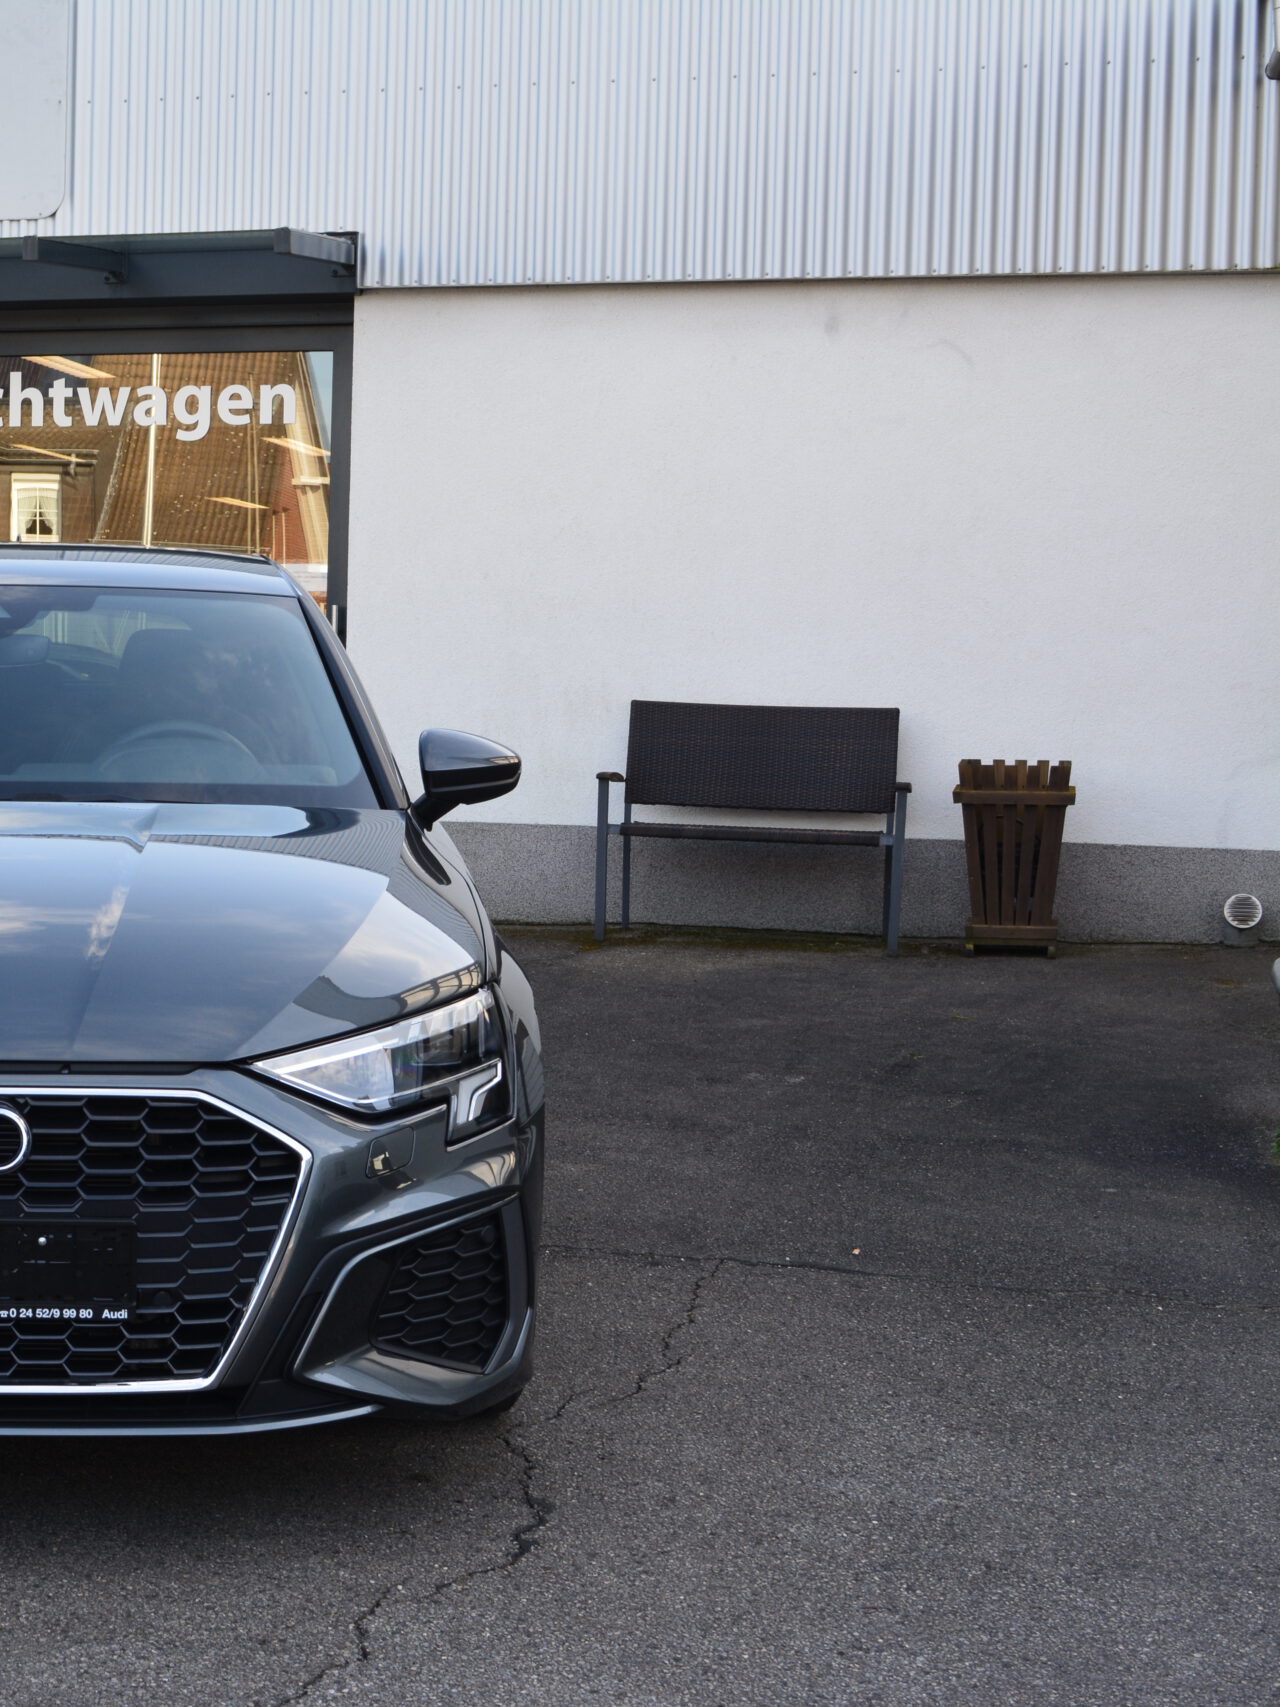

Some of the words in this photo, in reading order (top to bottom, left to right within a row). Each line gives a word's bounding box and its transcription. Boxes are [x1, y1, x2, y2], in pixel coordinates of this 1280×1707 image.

[19, 1307, 33, 1318] 24
[35, 1307, 60, 1319] 52/9
[63, 1308, 77, 1319] 99
[79, 1308, 93, 1319] 80
[102, 1308, 128, 1319] Audi
